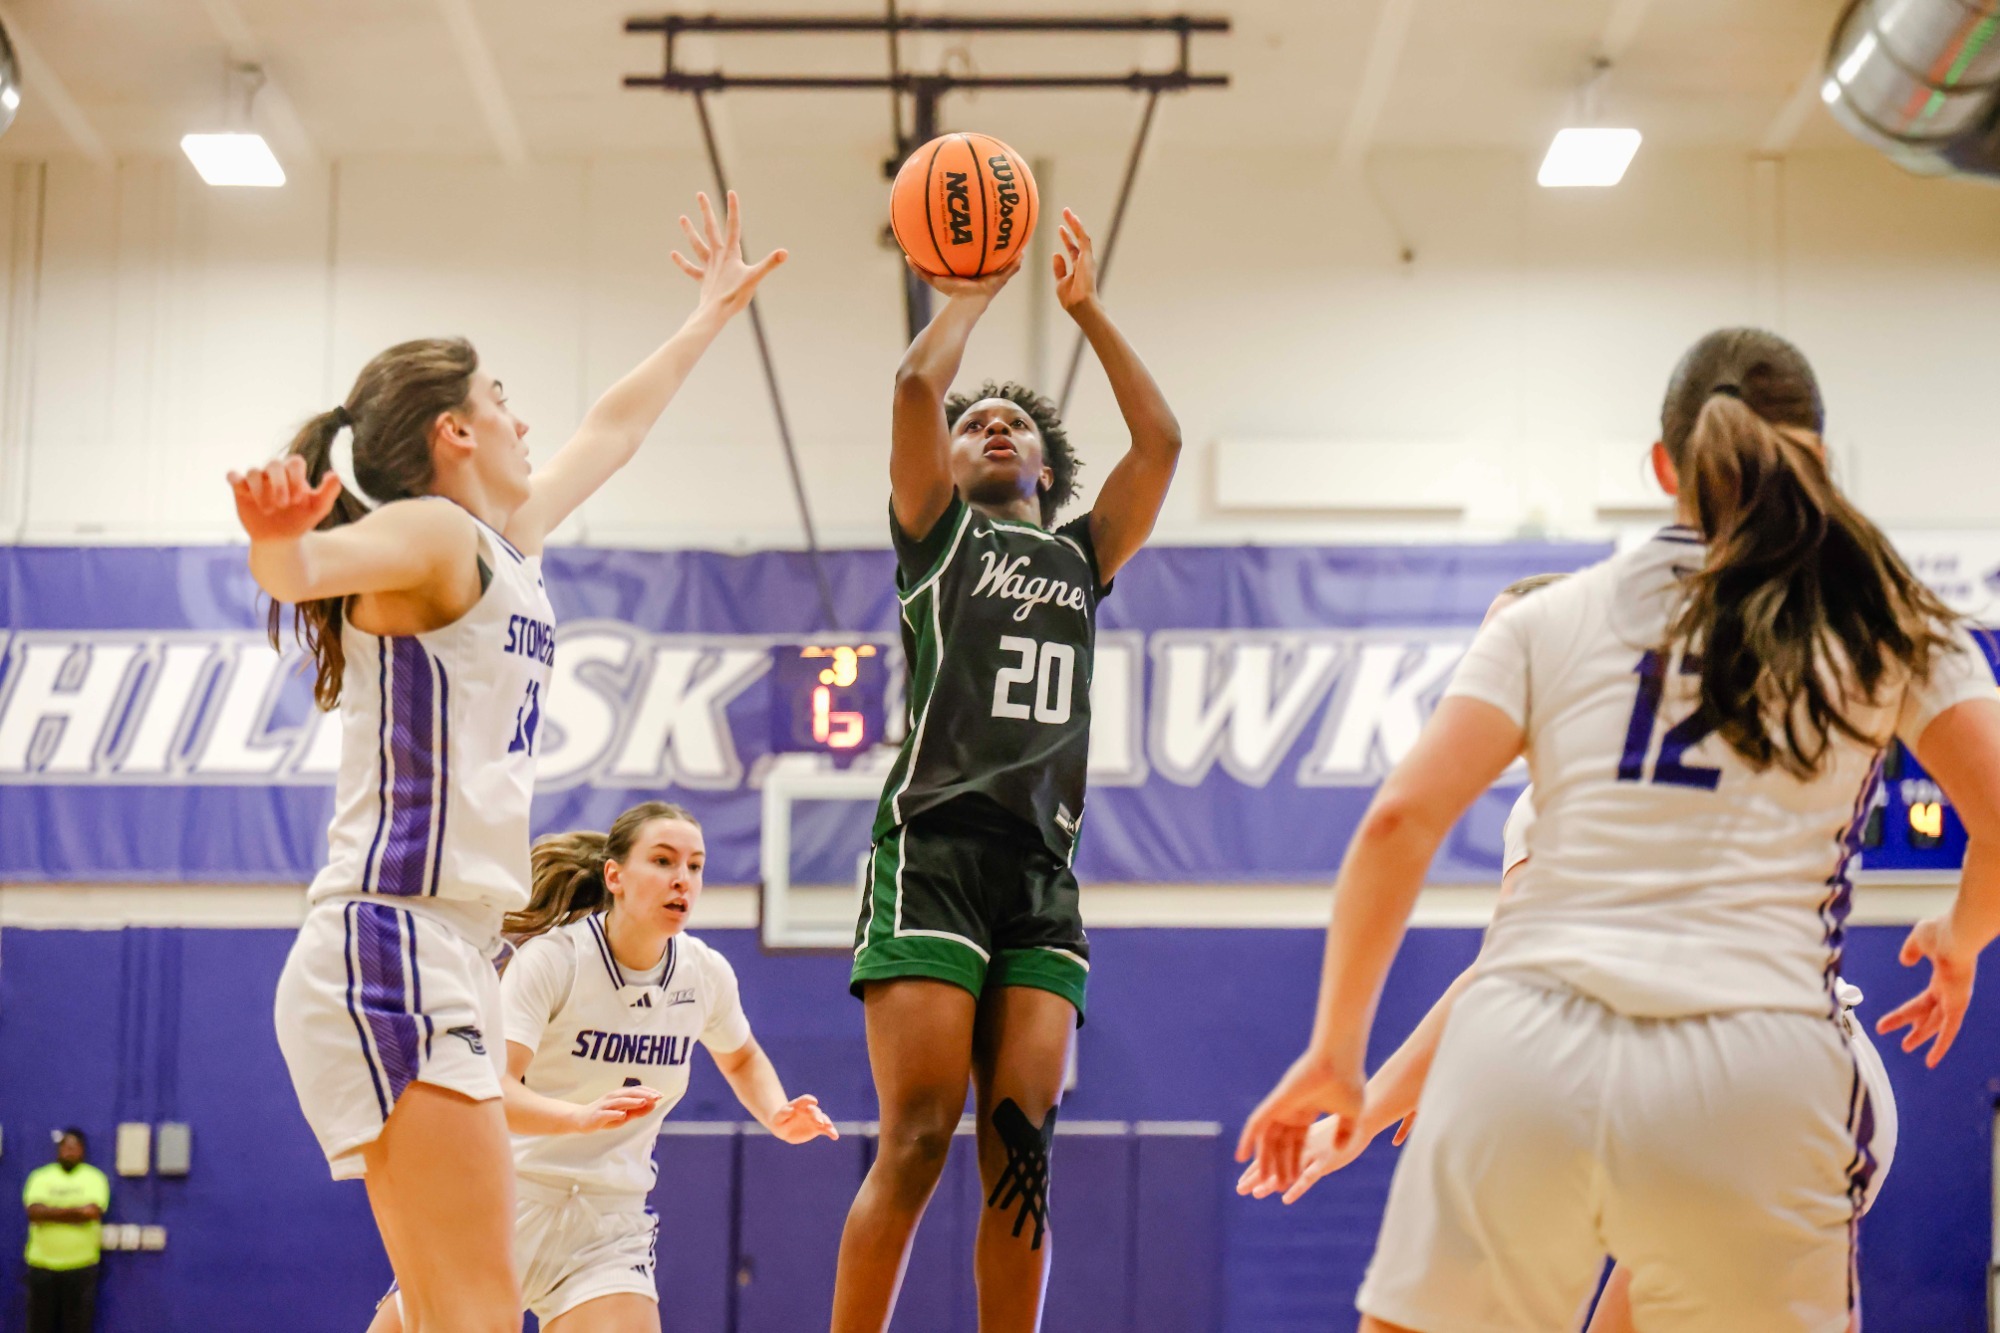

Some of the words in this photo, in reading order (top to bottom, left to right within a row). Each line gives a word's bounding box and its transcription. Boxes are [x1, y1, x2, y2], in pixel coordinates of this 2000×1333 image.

[946, 171, 974, 246] NCAA
[988, 153, 1020, 251] Wilson
[971, 551, 1087, 621] Wagne
[991, 635, 1075, 724] 20
[1617, 648, 1722, 792] 12
